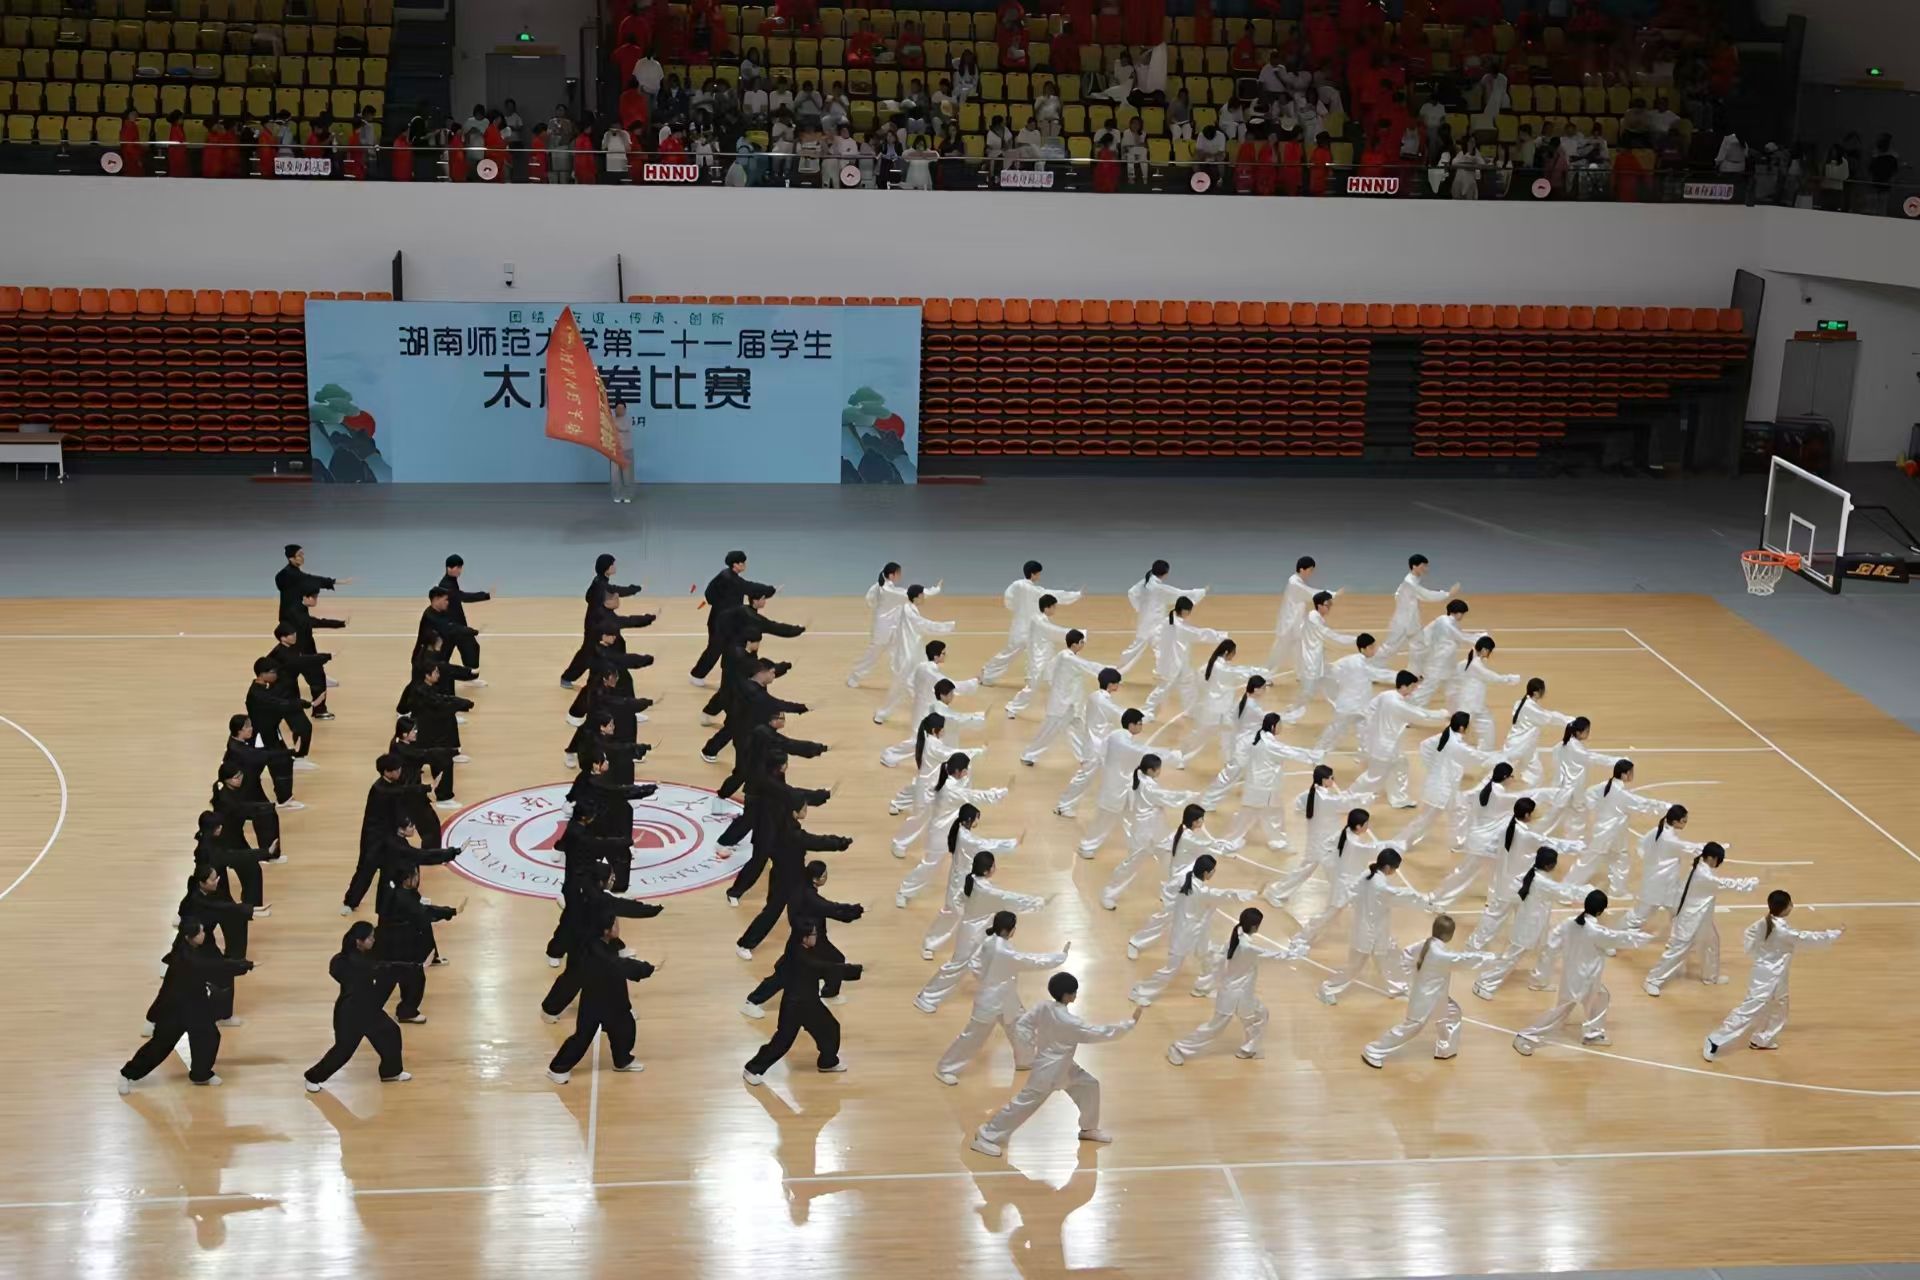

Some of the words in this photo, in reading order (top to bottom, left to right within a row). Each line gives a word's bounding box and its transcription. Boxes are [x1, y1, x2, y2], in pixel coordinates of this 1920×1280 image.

[645, 164, 699, 181] HNNU
[1348, 177, 1399, 194] HNNU
[484, 364, 751, 410] 太拳比赛
